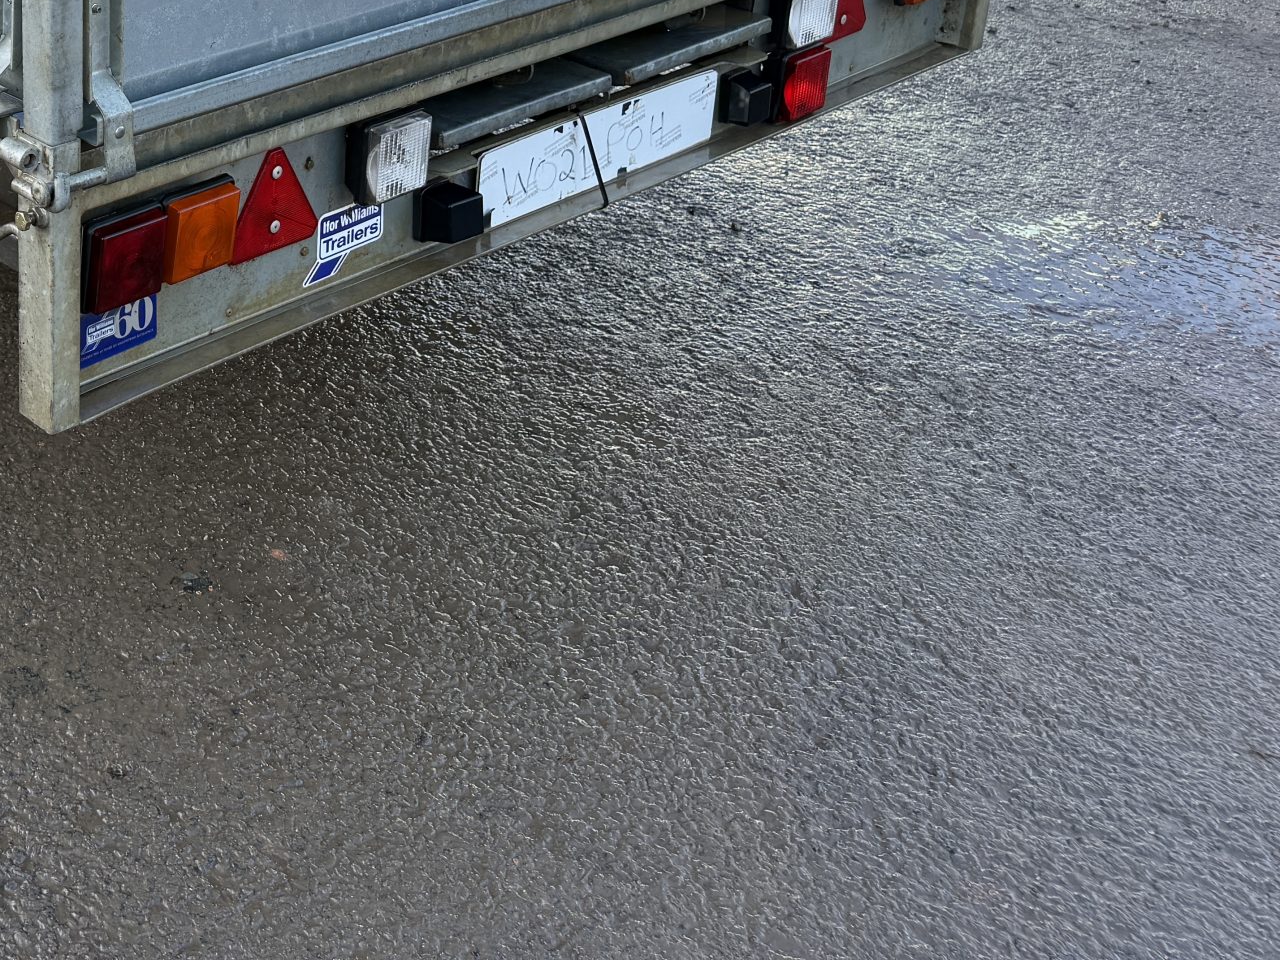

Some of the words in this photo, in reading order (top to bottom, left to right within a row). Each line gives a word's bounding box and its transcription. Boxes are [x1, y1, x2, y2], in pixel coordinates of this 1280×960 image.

[323, 220, 339, 234] Ifor
[340, 205, 379, 227] Wlliams
[323, 223, 378, 253] Trailers
[114, 296, 154, 339] 60
